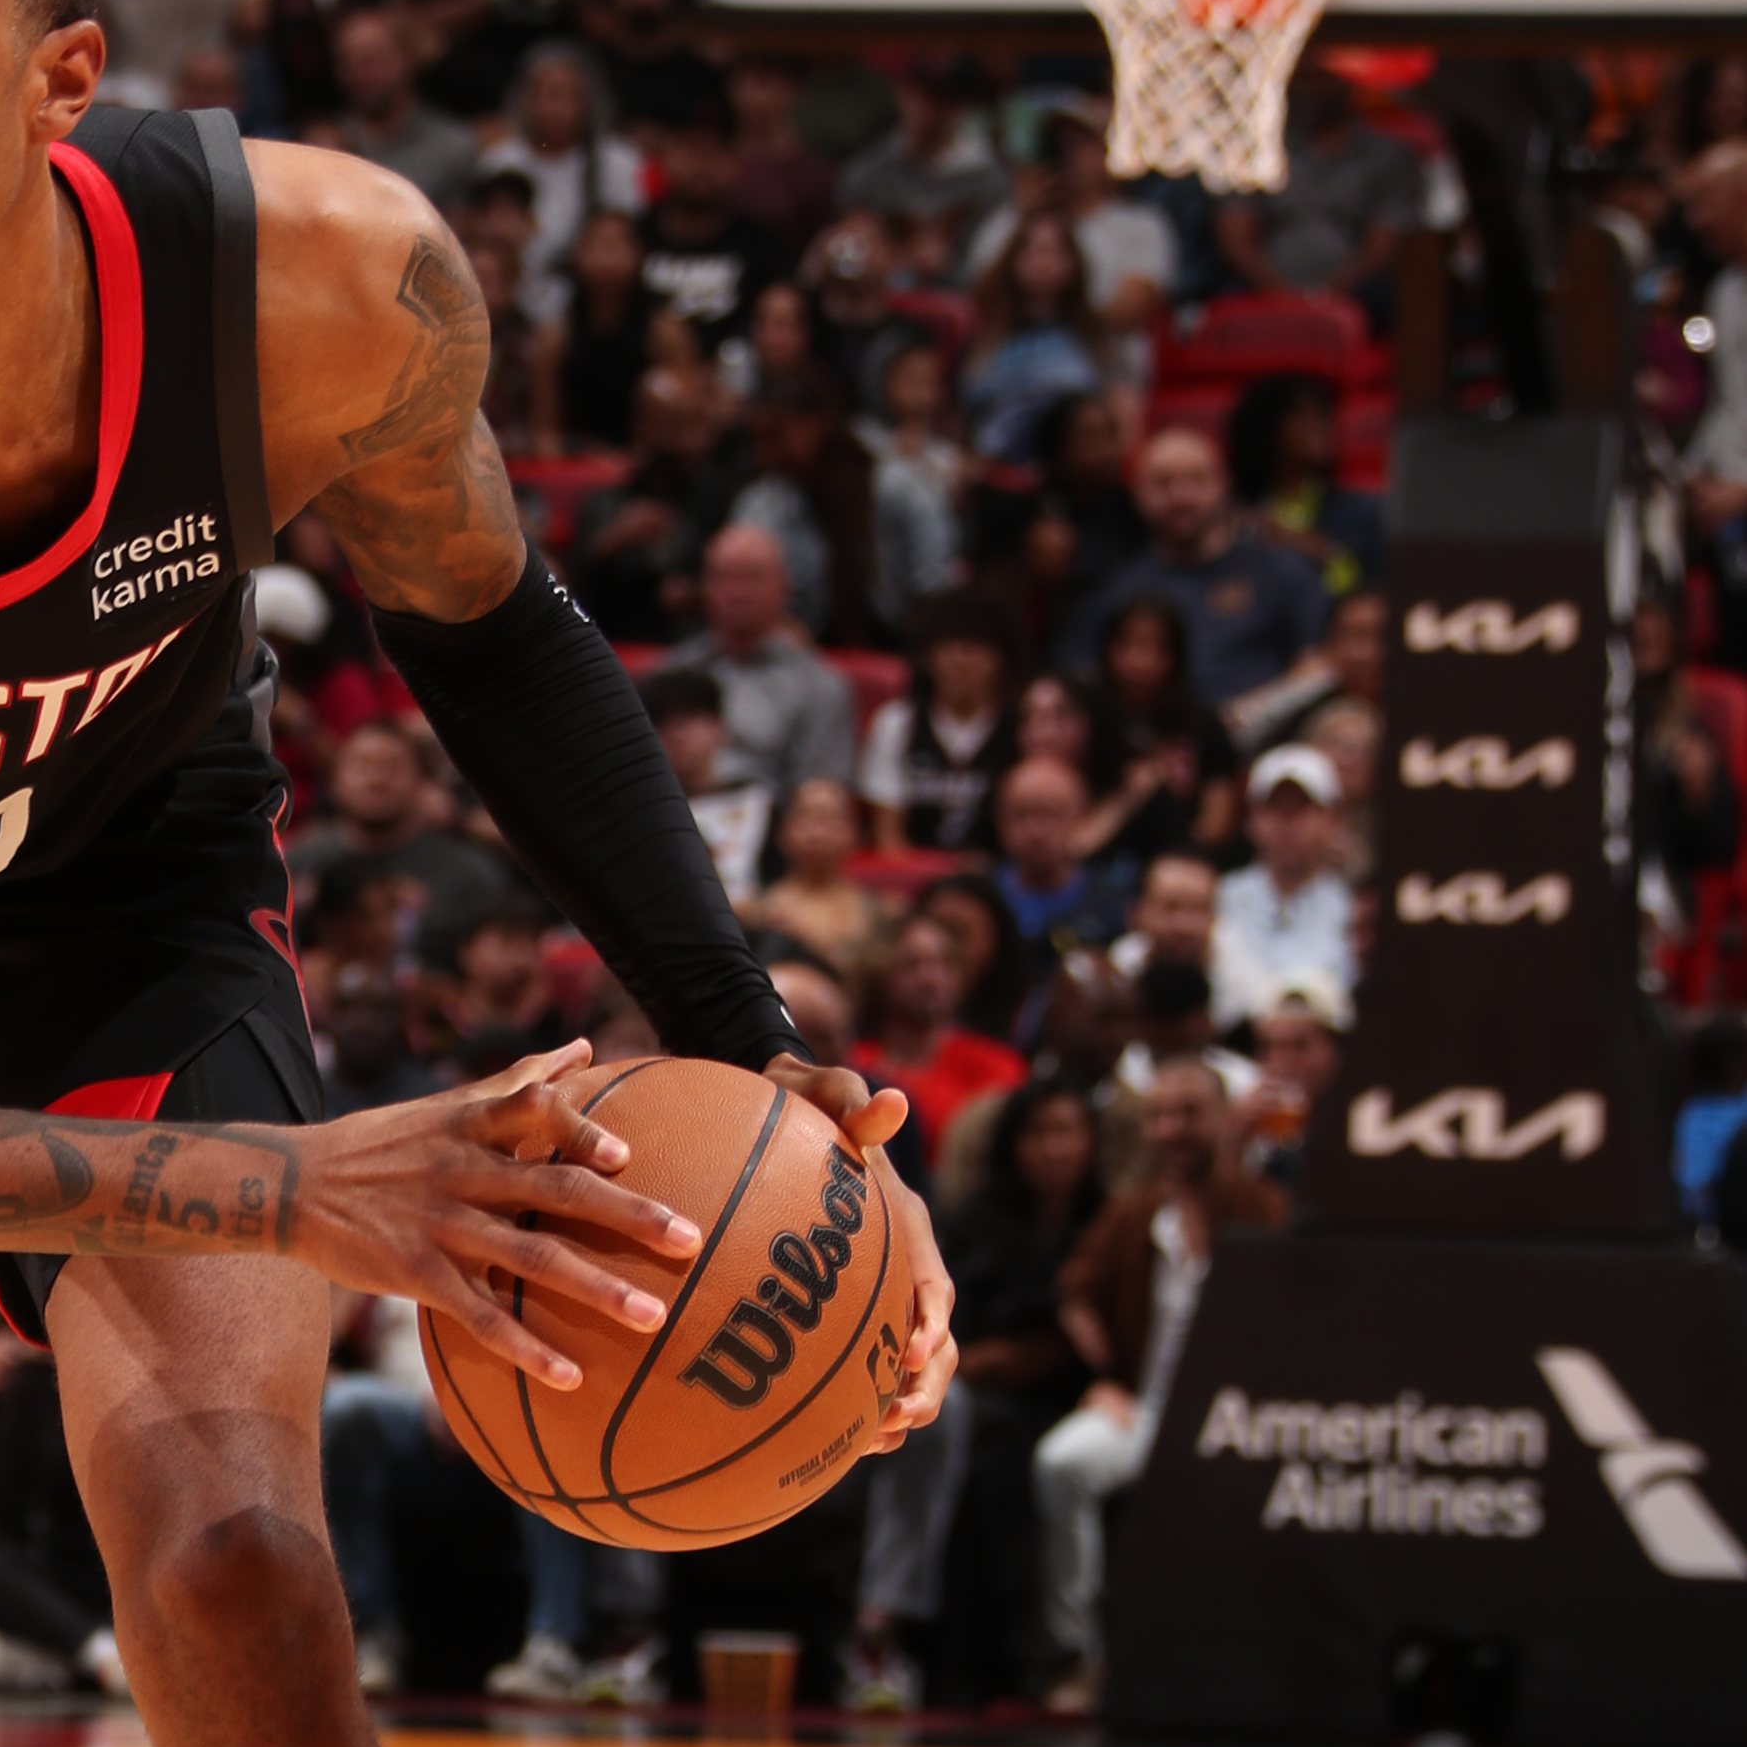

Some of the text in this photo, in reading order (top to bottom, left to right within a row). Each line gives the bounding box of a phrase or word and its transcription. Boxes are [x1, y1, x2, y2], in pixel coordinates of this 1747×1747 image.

[93, 511, 218, 579] credit
[91, 550, 221, 621] karma
[678, 1141, 869, 1411] Wilson
[1196, 1386, 1549, 1468] American
[777, 1454, 821, 1489] OFFICIAL
[1262, 1460, 1546, 1539] Airlines
